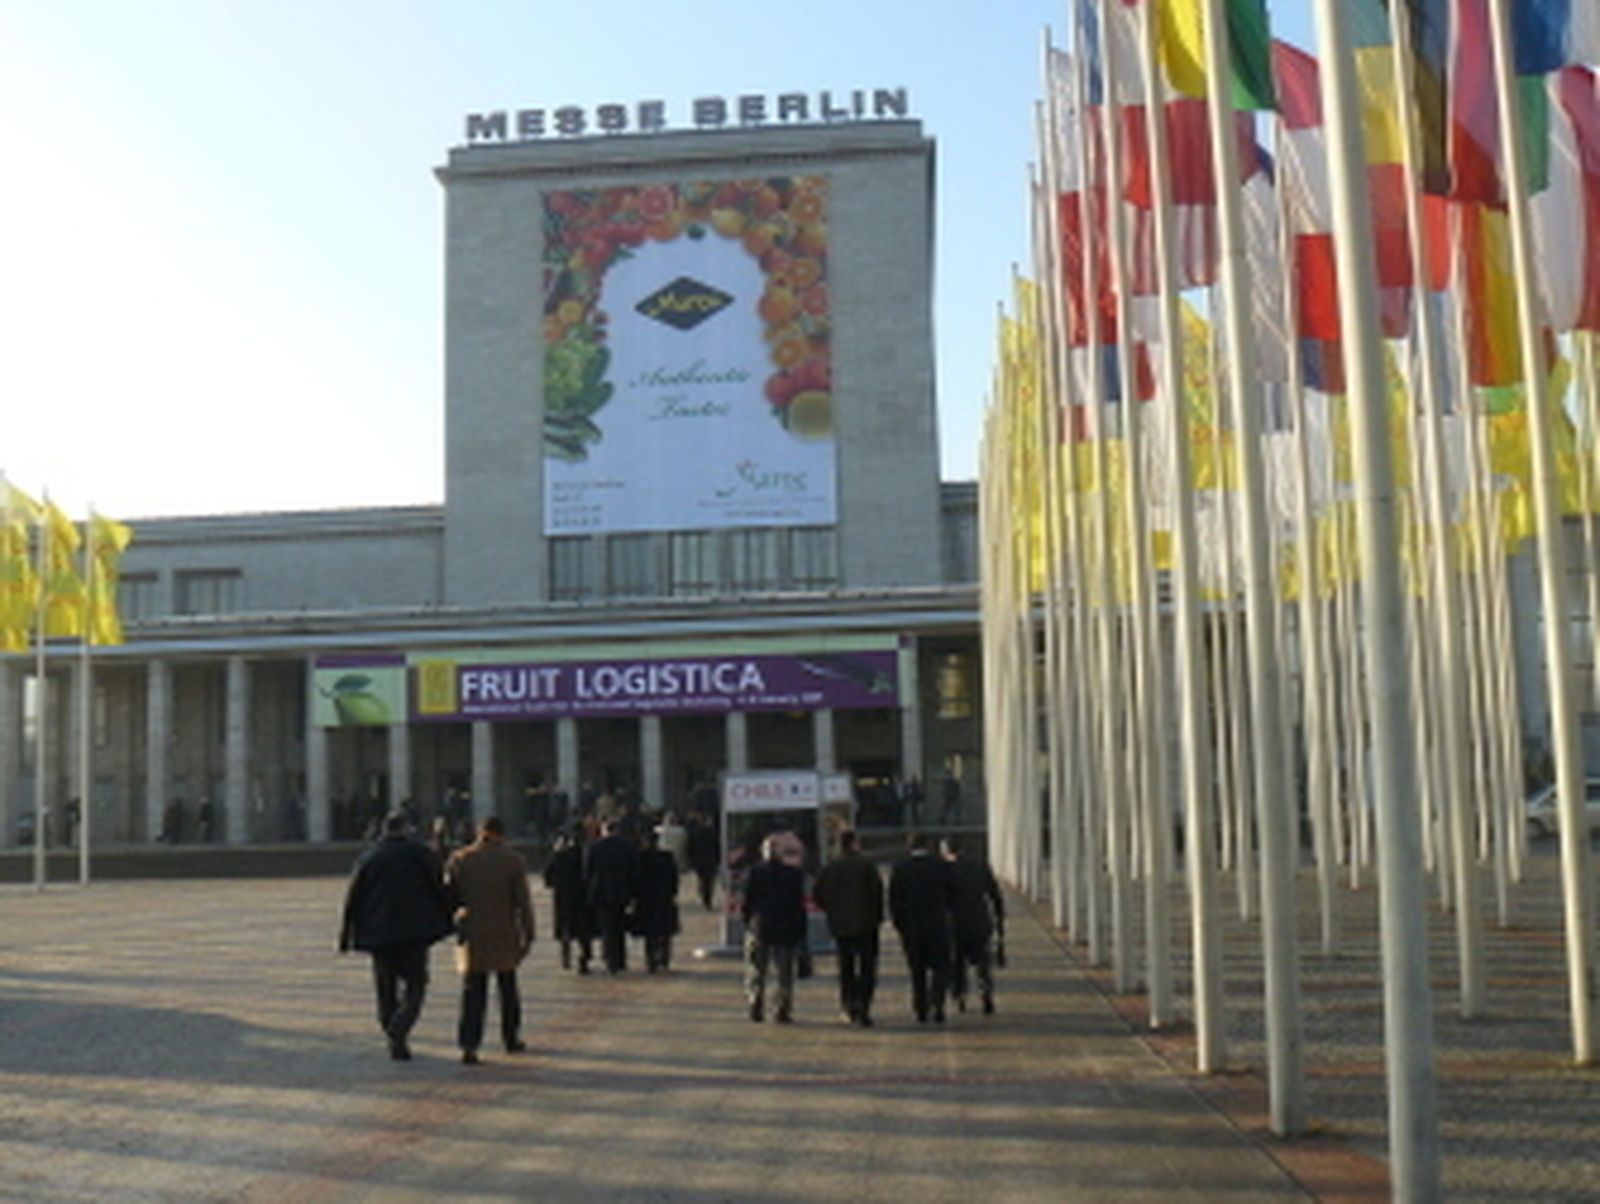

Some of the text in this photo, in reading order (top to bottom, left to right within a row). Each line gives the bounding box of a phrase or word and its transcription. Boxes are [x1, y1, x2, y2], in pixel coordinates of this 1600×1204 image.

[466, 87, 909, 140] MESSE BERLIN
[461, 662, 765, 702] FRUIT LOGISTICA
